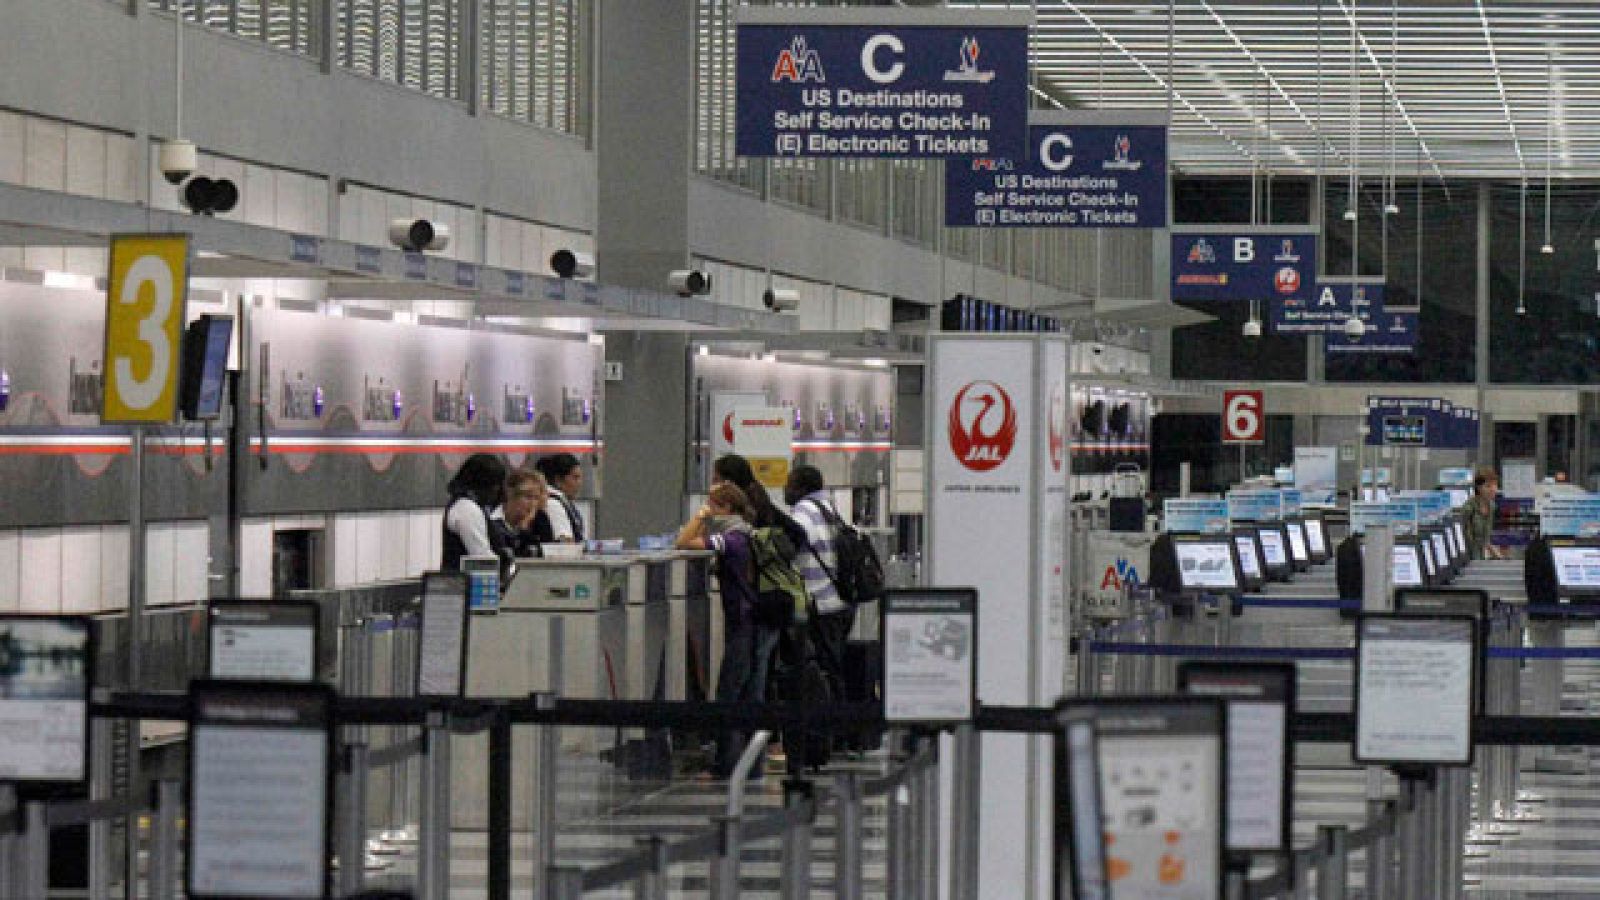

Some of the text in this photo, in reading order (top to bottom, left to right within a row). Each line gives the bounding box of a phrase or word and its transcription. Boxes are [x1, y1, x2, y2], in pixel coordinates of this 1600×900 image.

[861, 34, 905, 83] C
[801, 89, 963, 108] US Destinations
[774, 109, 991, 131] Self Service Check-In
[776, 133, 989, 155] (E) Electronic Tickets
[1040, 133, 1074, 171] C
[994, 174, 1118, 190] US Destinations
[974, 191, 1138, 207] Self Service Check-In
[974, 209, 1137, 226] (E) Electronic Tickets
[1234, 236, 1255, 262] B
[1319, 287, 1336, 306] A
[115, 254, 174, 411] 3
[1227, 394, 1258, 438] 6
[964, 443, 1003, 461] JAL
